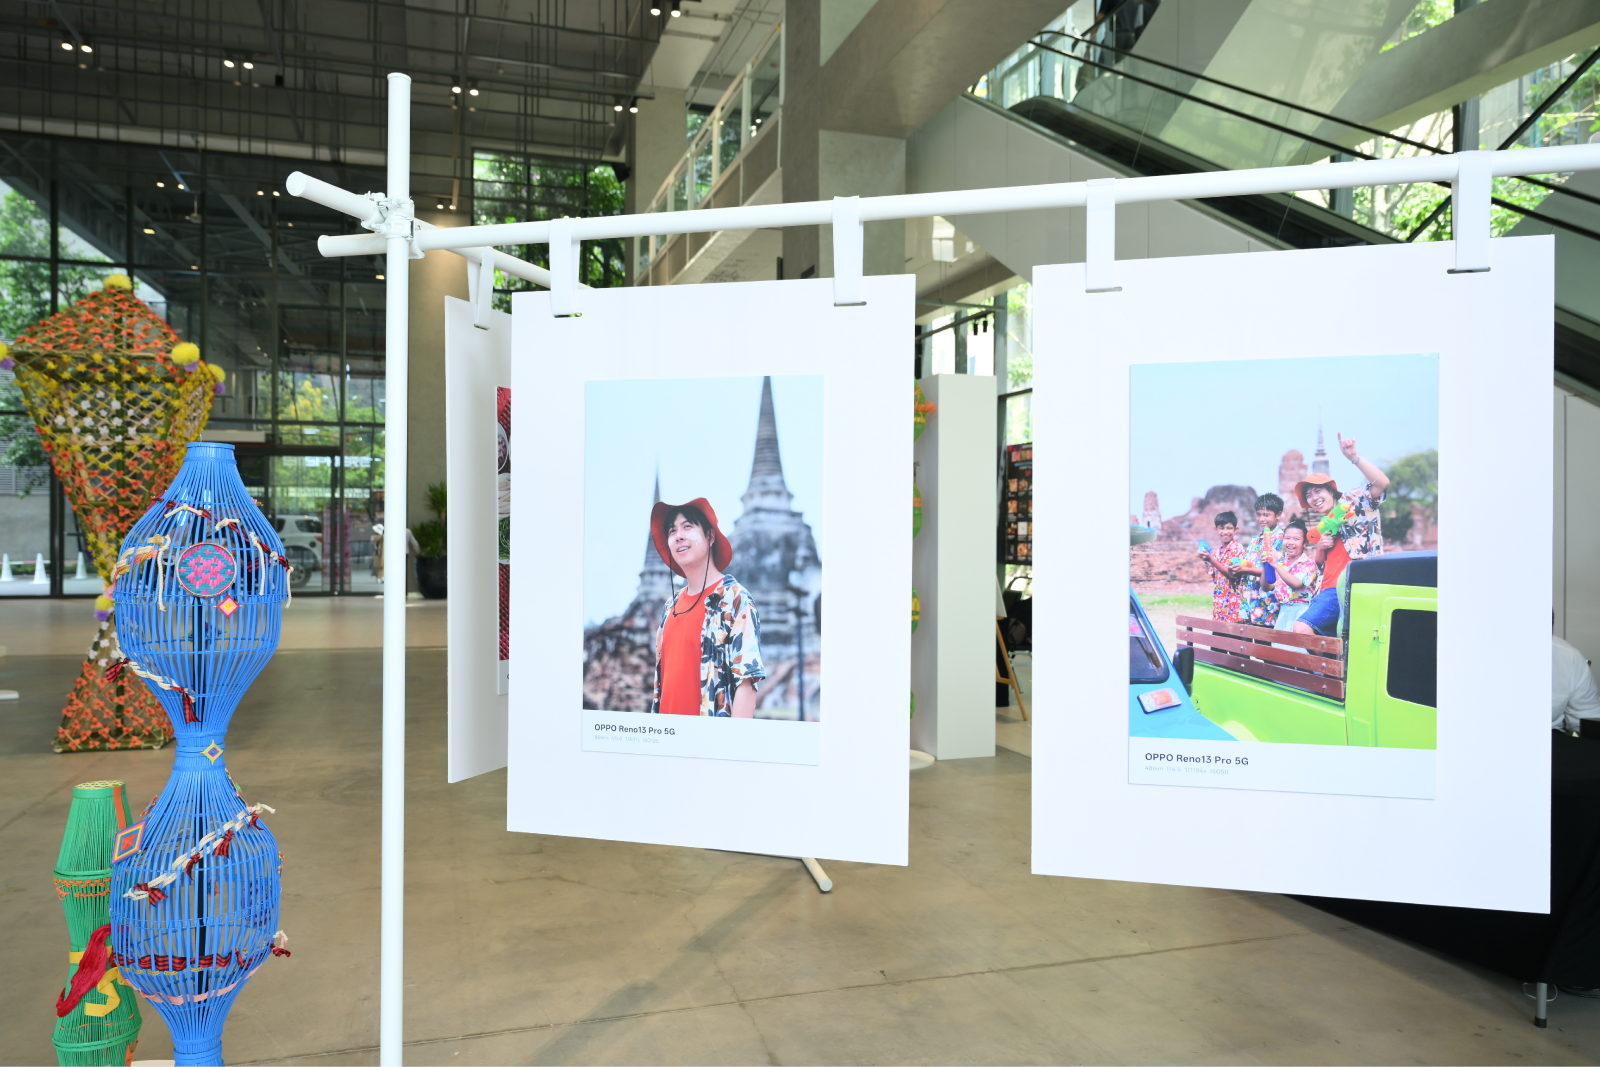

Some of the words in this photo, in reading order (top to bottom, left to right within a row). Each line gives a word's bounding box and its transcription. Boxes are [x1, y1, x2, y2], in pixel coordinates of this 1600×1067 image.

[594, 723, 617, 732] OPPO
[618, 725, 647, 734] Reno13
[648, 726, 662, 735] Pro
[664, 727, 676, 735] 5G
[1145, 752, 1174, 762] OPPO
[1176, 754, 1212, 764] Reno13
[1214, 755, 1232, 765] Pro
[1234, 756, 1249, 766] 5G
